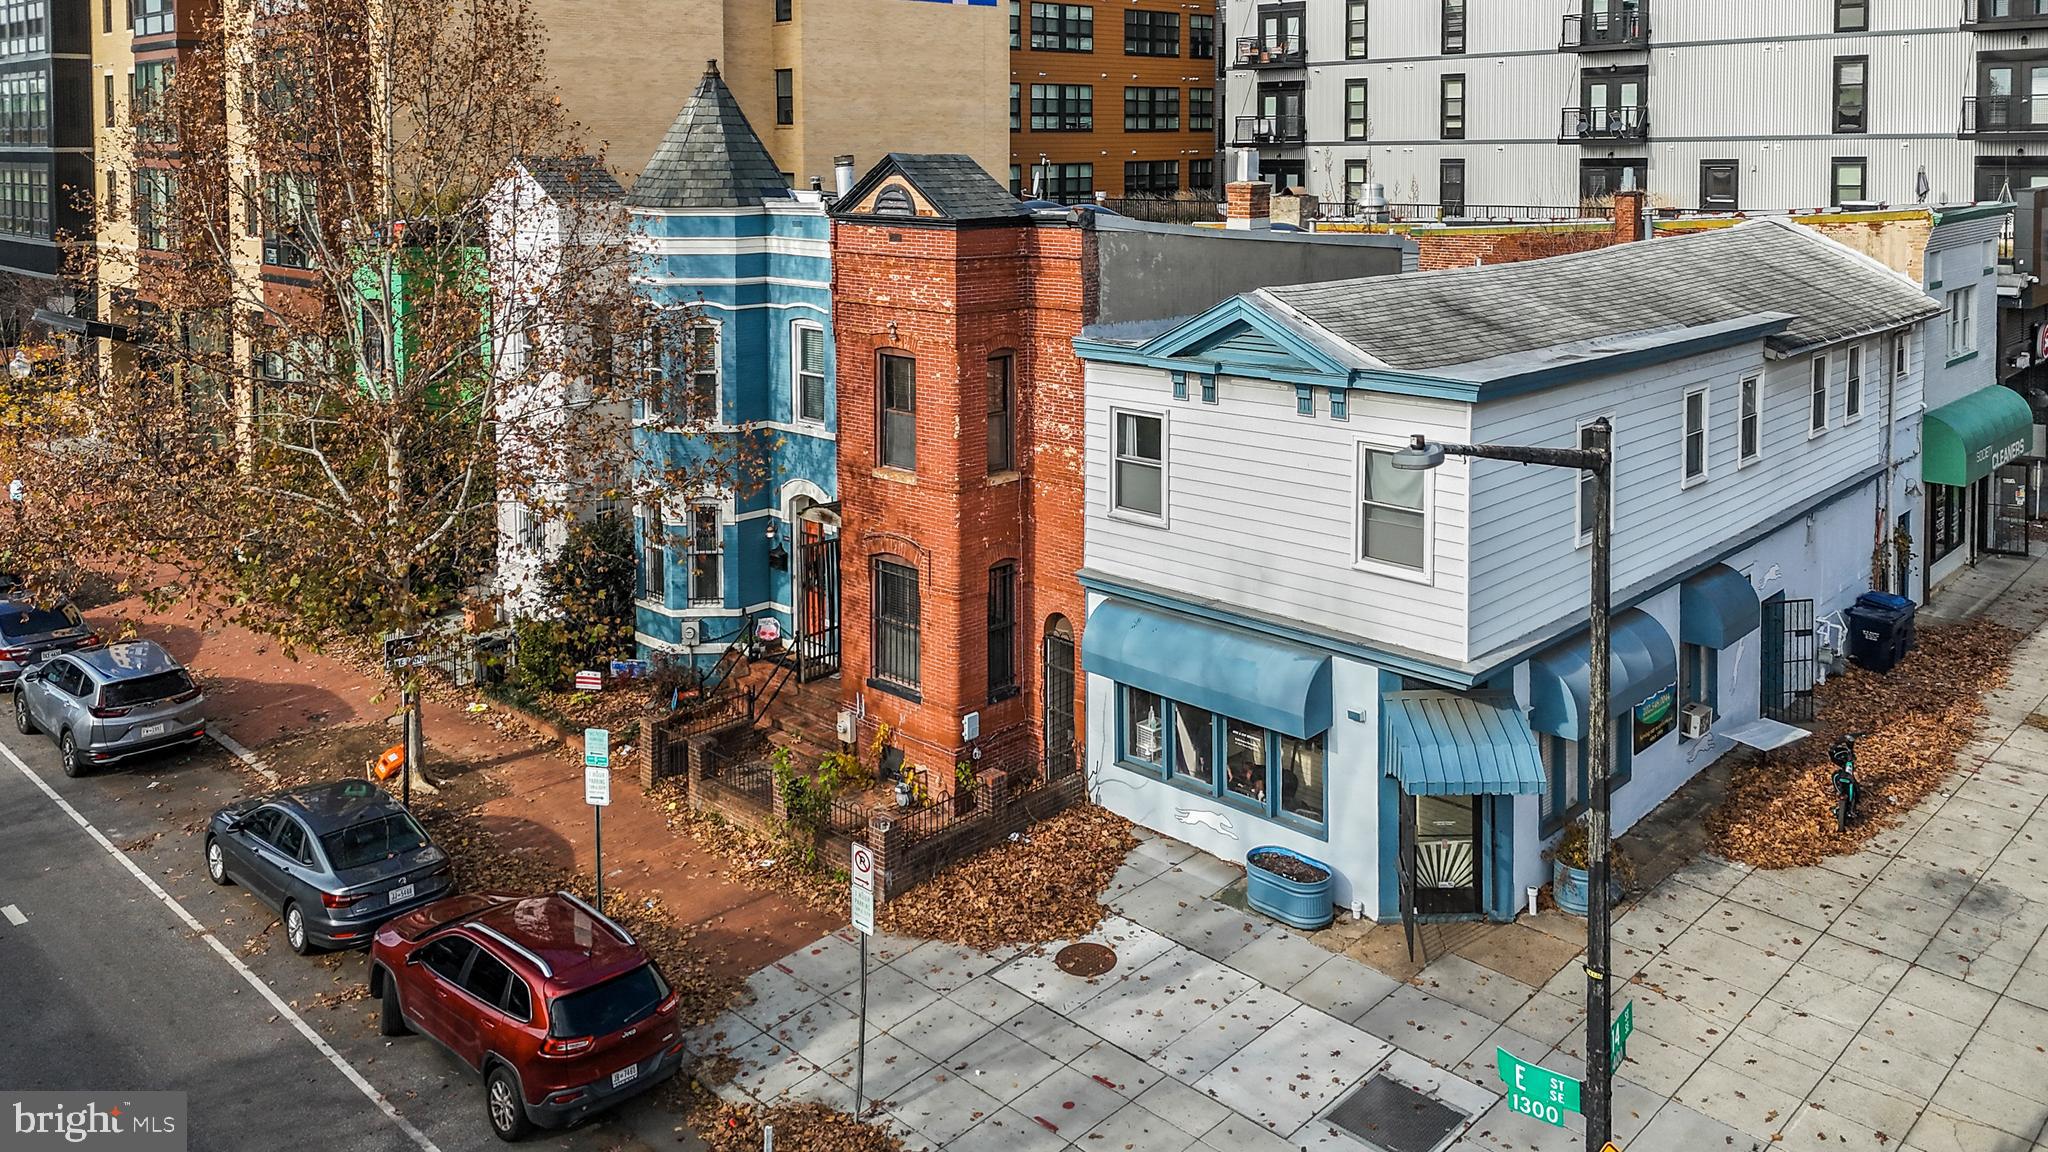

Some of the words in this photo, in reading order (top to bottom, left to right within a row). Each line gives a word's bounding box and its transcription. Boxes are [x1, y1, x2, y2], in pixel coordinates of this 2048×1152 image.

[1992, 437, 2025, 471] CLEANERS
[1515, 1063, 1526, 1092] E
[1550, 1077, 1565, 1091] ST
[1513, 1094, 1559, 1123] 1300
[1549, 1090, 1565, 1104] SE
